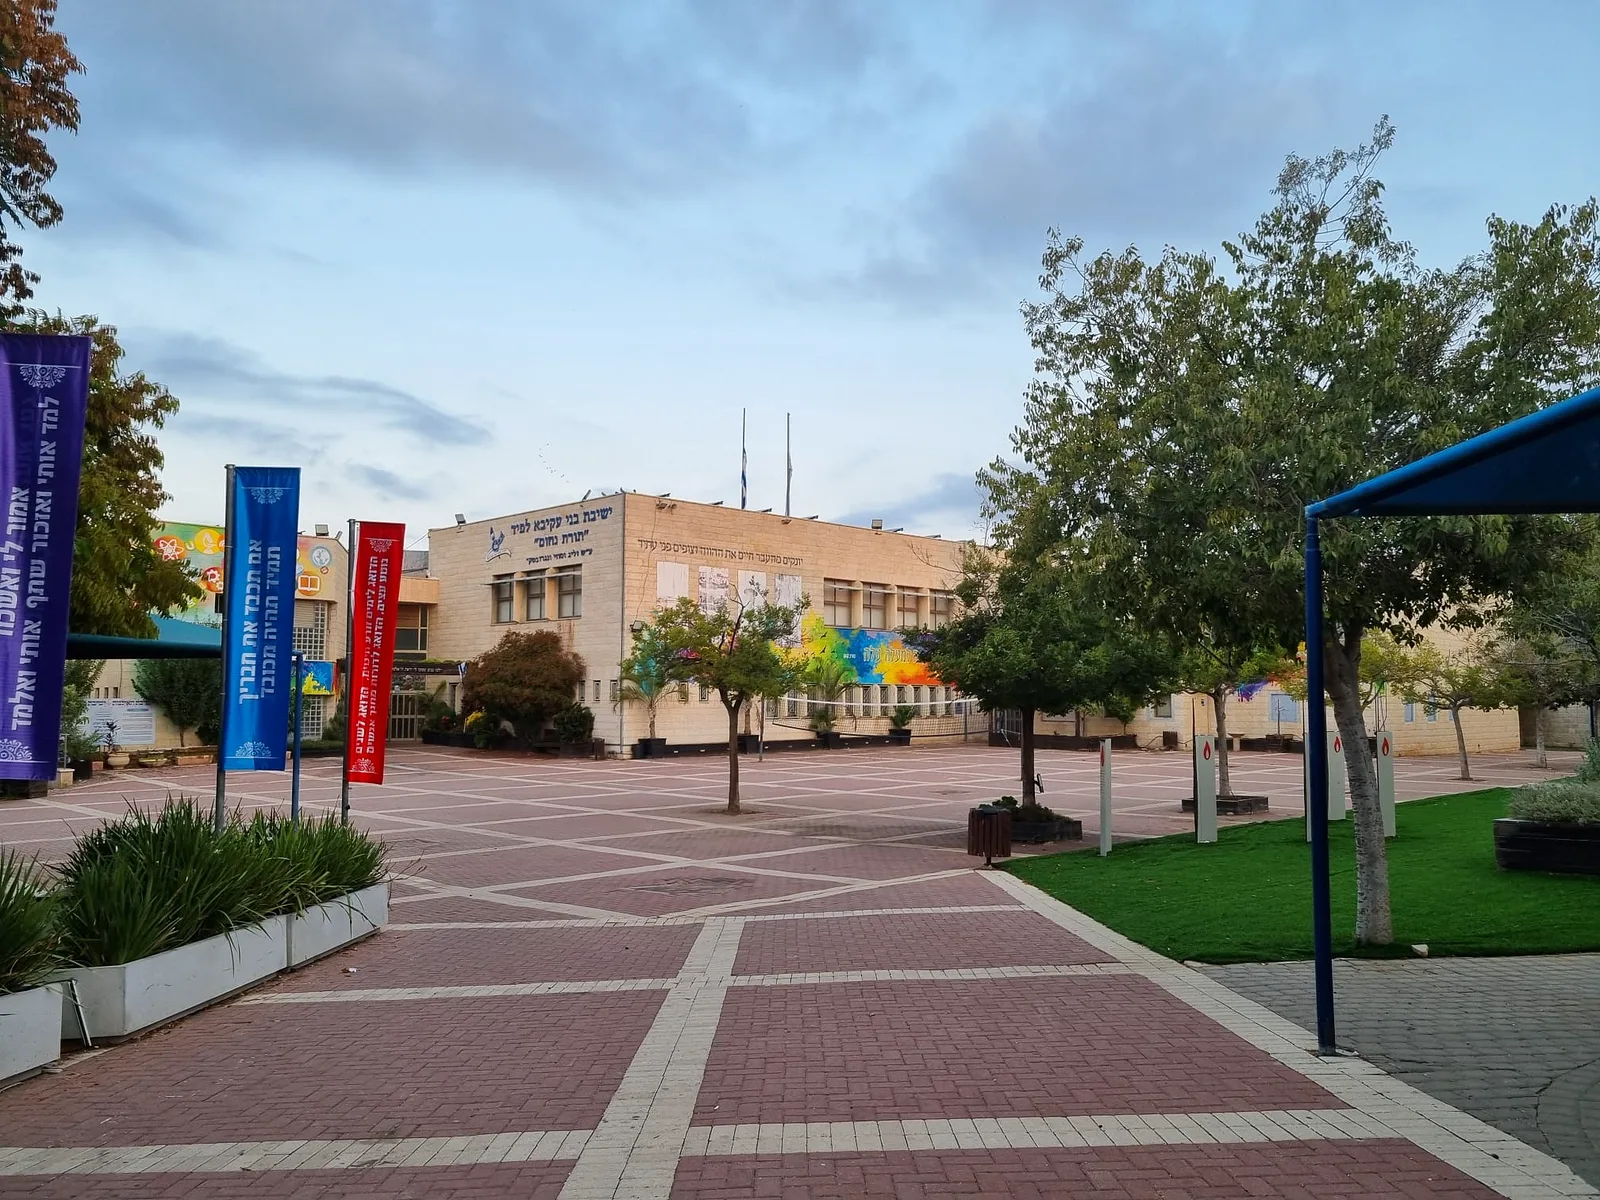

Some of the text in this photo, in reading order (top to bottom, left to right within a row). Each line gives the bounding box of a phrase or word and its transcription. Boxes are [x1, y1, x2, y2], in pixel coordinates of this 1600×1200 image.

[6, 486, 30, 535] אמור
[510, 507, 612, 535] ישיבת בני עקיבא לפיד
[0, 541, 24, 562] לי
[638, 539, 658, 551] עתיד
[660, 542, 672, 552] פני
[674, 543, 698, 554] וצופים
[724, 549, 737, 559] את
[738, 551, 754, 560] חיים
[756, 554, 782, 564] מהעבר
[8, 396, 60, 730] למד אותי ואזכור שתף אותי ואלמד
[368, 556, 378, 586] הדואג
[380, 558, 388, 582] נוטע
[782, 557, 804, 568] יונקים
[366, 589, 375, 618] לימים
[377, 586, 386, 614] עצים,
[239, 540, 262, 704] אם תכבד את חבריך
[261, 546, 280, 698] תמיד תהיה מכובד
[374, 618, 384, 648] הדואג
[371, 652, 380, 686] לדורות
[358, 686, 368, 718] הדואג
[356, 720, 366, 754] לשנים
[366, 720, 375, 754] אנשים
